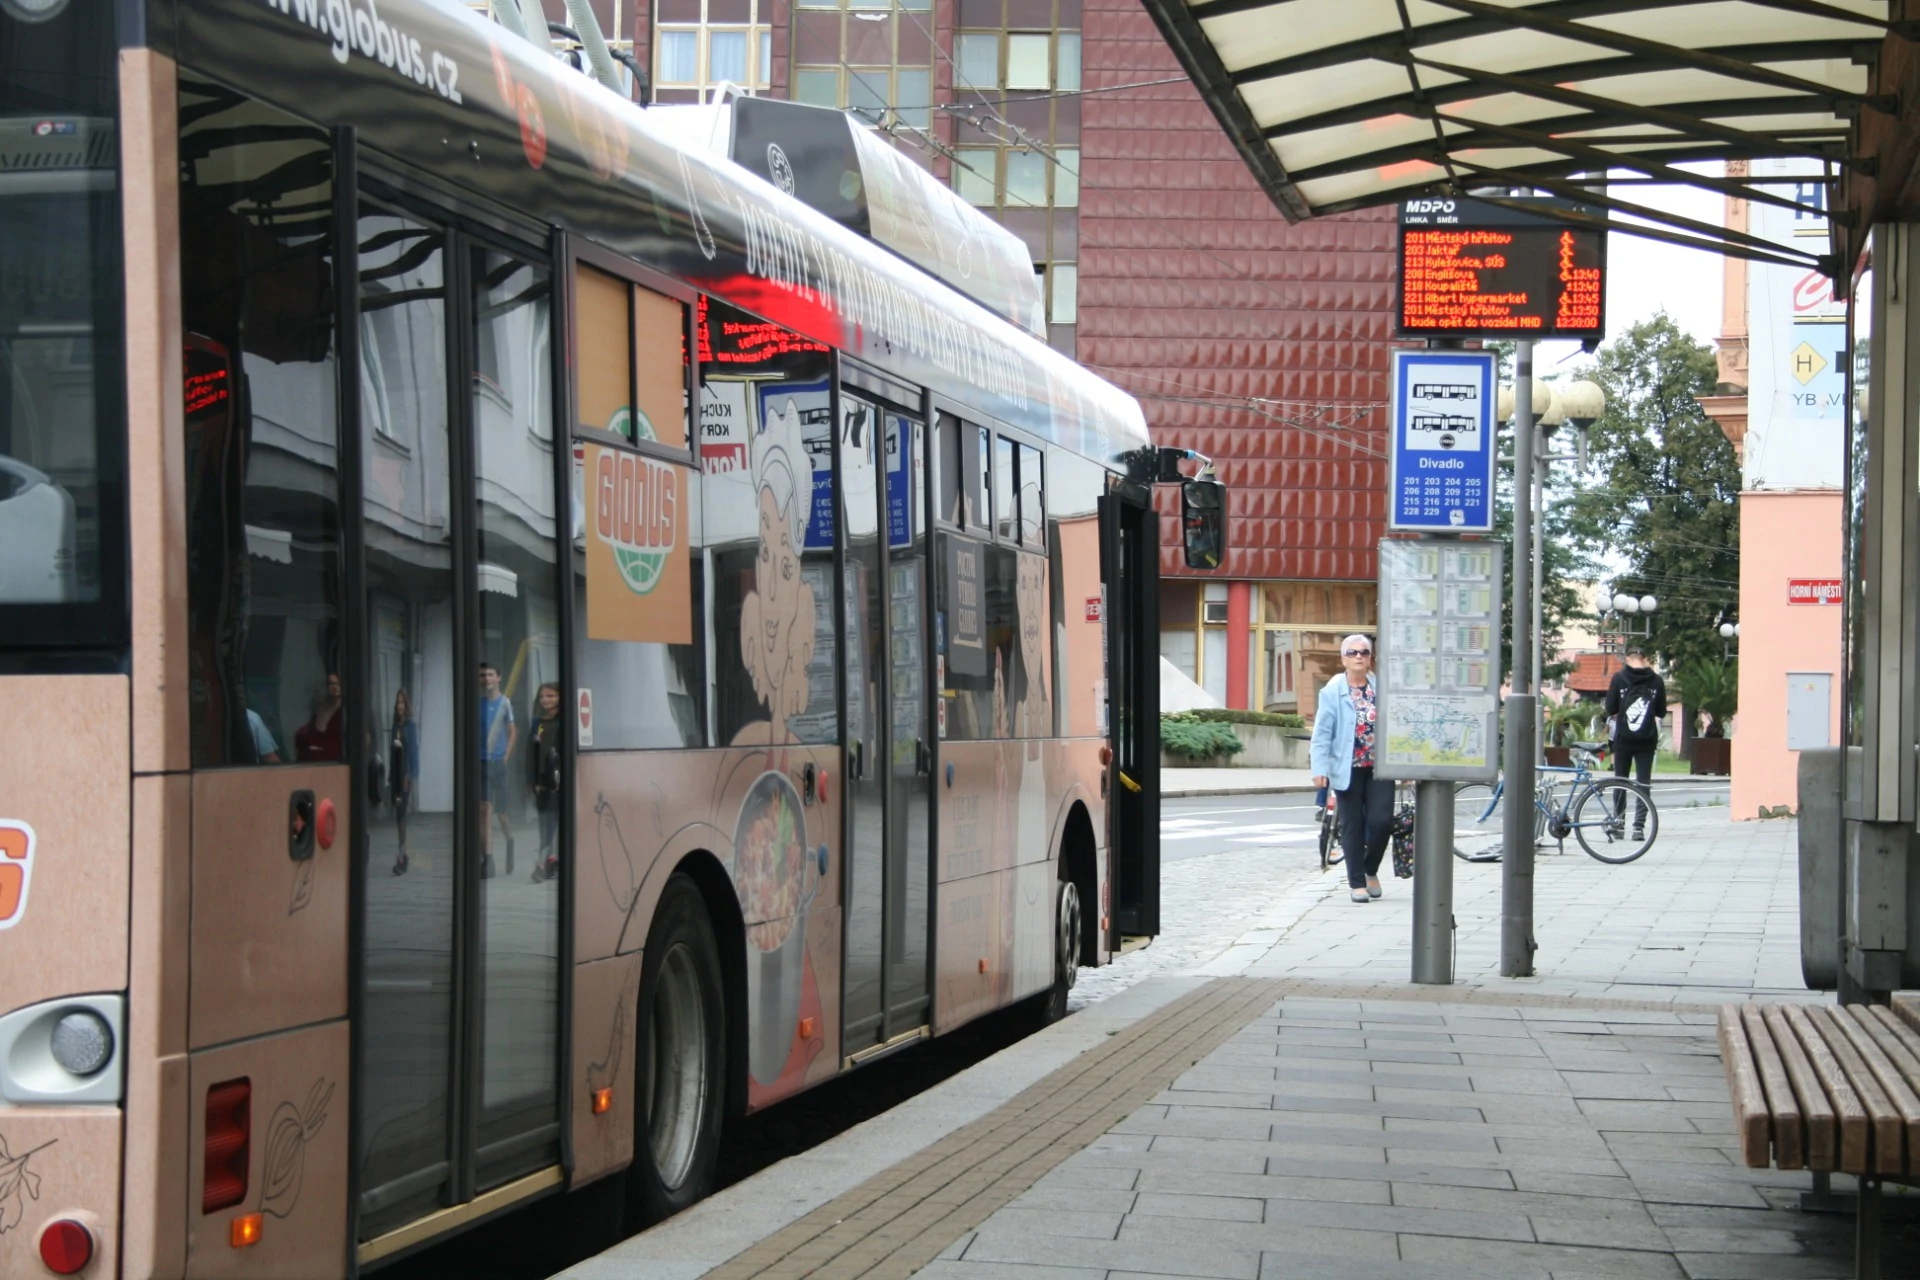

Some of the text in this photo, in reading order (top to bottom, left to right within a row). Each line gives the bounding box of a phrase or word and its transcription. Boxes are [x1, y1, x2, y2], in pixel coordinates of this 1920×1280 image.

[1406, 200, 1455, 213] MDPO
[1405, 215, 1458, 224] LINKA SMĚR
[1405, 231, 1512, 245] 201 Městský hřbitov
[1405, 243, 1460, 255] 203 Jaktař
[1405, 256, 1424, 267] 213
[1405, 267, 1600, 280] 208 Englišova 13:40
[1404, 280, 1423, 291] 218
[1425, 279, 1478, 292] Koupaliště
[1404, 292, 1423, 303] 221
[1425, 292, 1457, 304] Albert
[1459, 292, 1527, 304] hypermarket
[1404, 303, 1599, 316] 201 Městský hřbitov 13:50
[1411, 317, 1436, 328] bude
[1439, 315, 1462, 328] opět
[1464, 317, 1478, 327] do
[1480, 317, 1518, 328] vozidel
[1520, 317, 1541, 328] MHD
[1797, 354, 1812, 373] H
[1419, 457, 1465, 469] Divadlo
[1404, 477, 1481, 486] 201 203 204 205
[1404, 487, 1481, 496] 206 208 209 213
[1404, 497, 1480, 506] 215 216 218 221
[1403, 507, 1440, 516] 228 229
[1790, 582, 1842, 598] HORNÍ NÁMĚSTÍ
